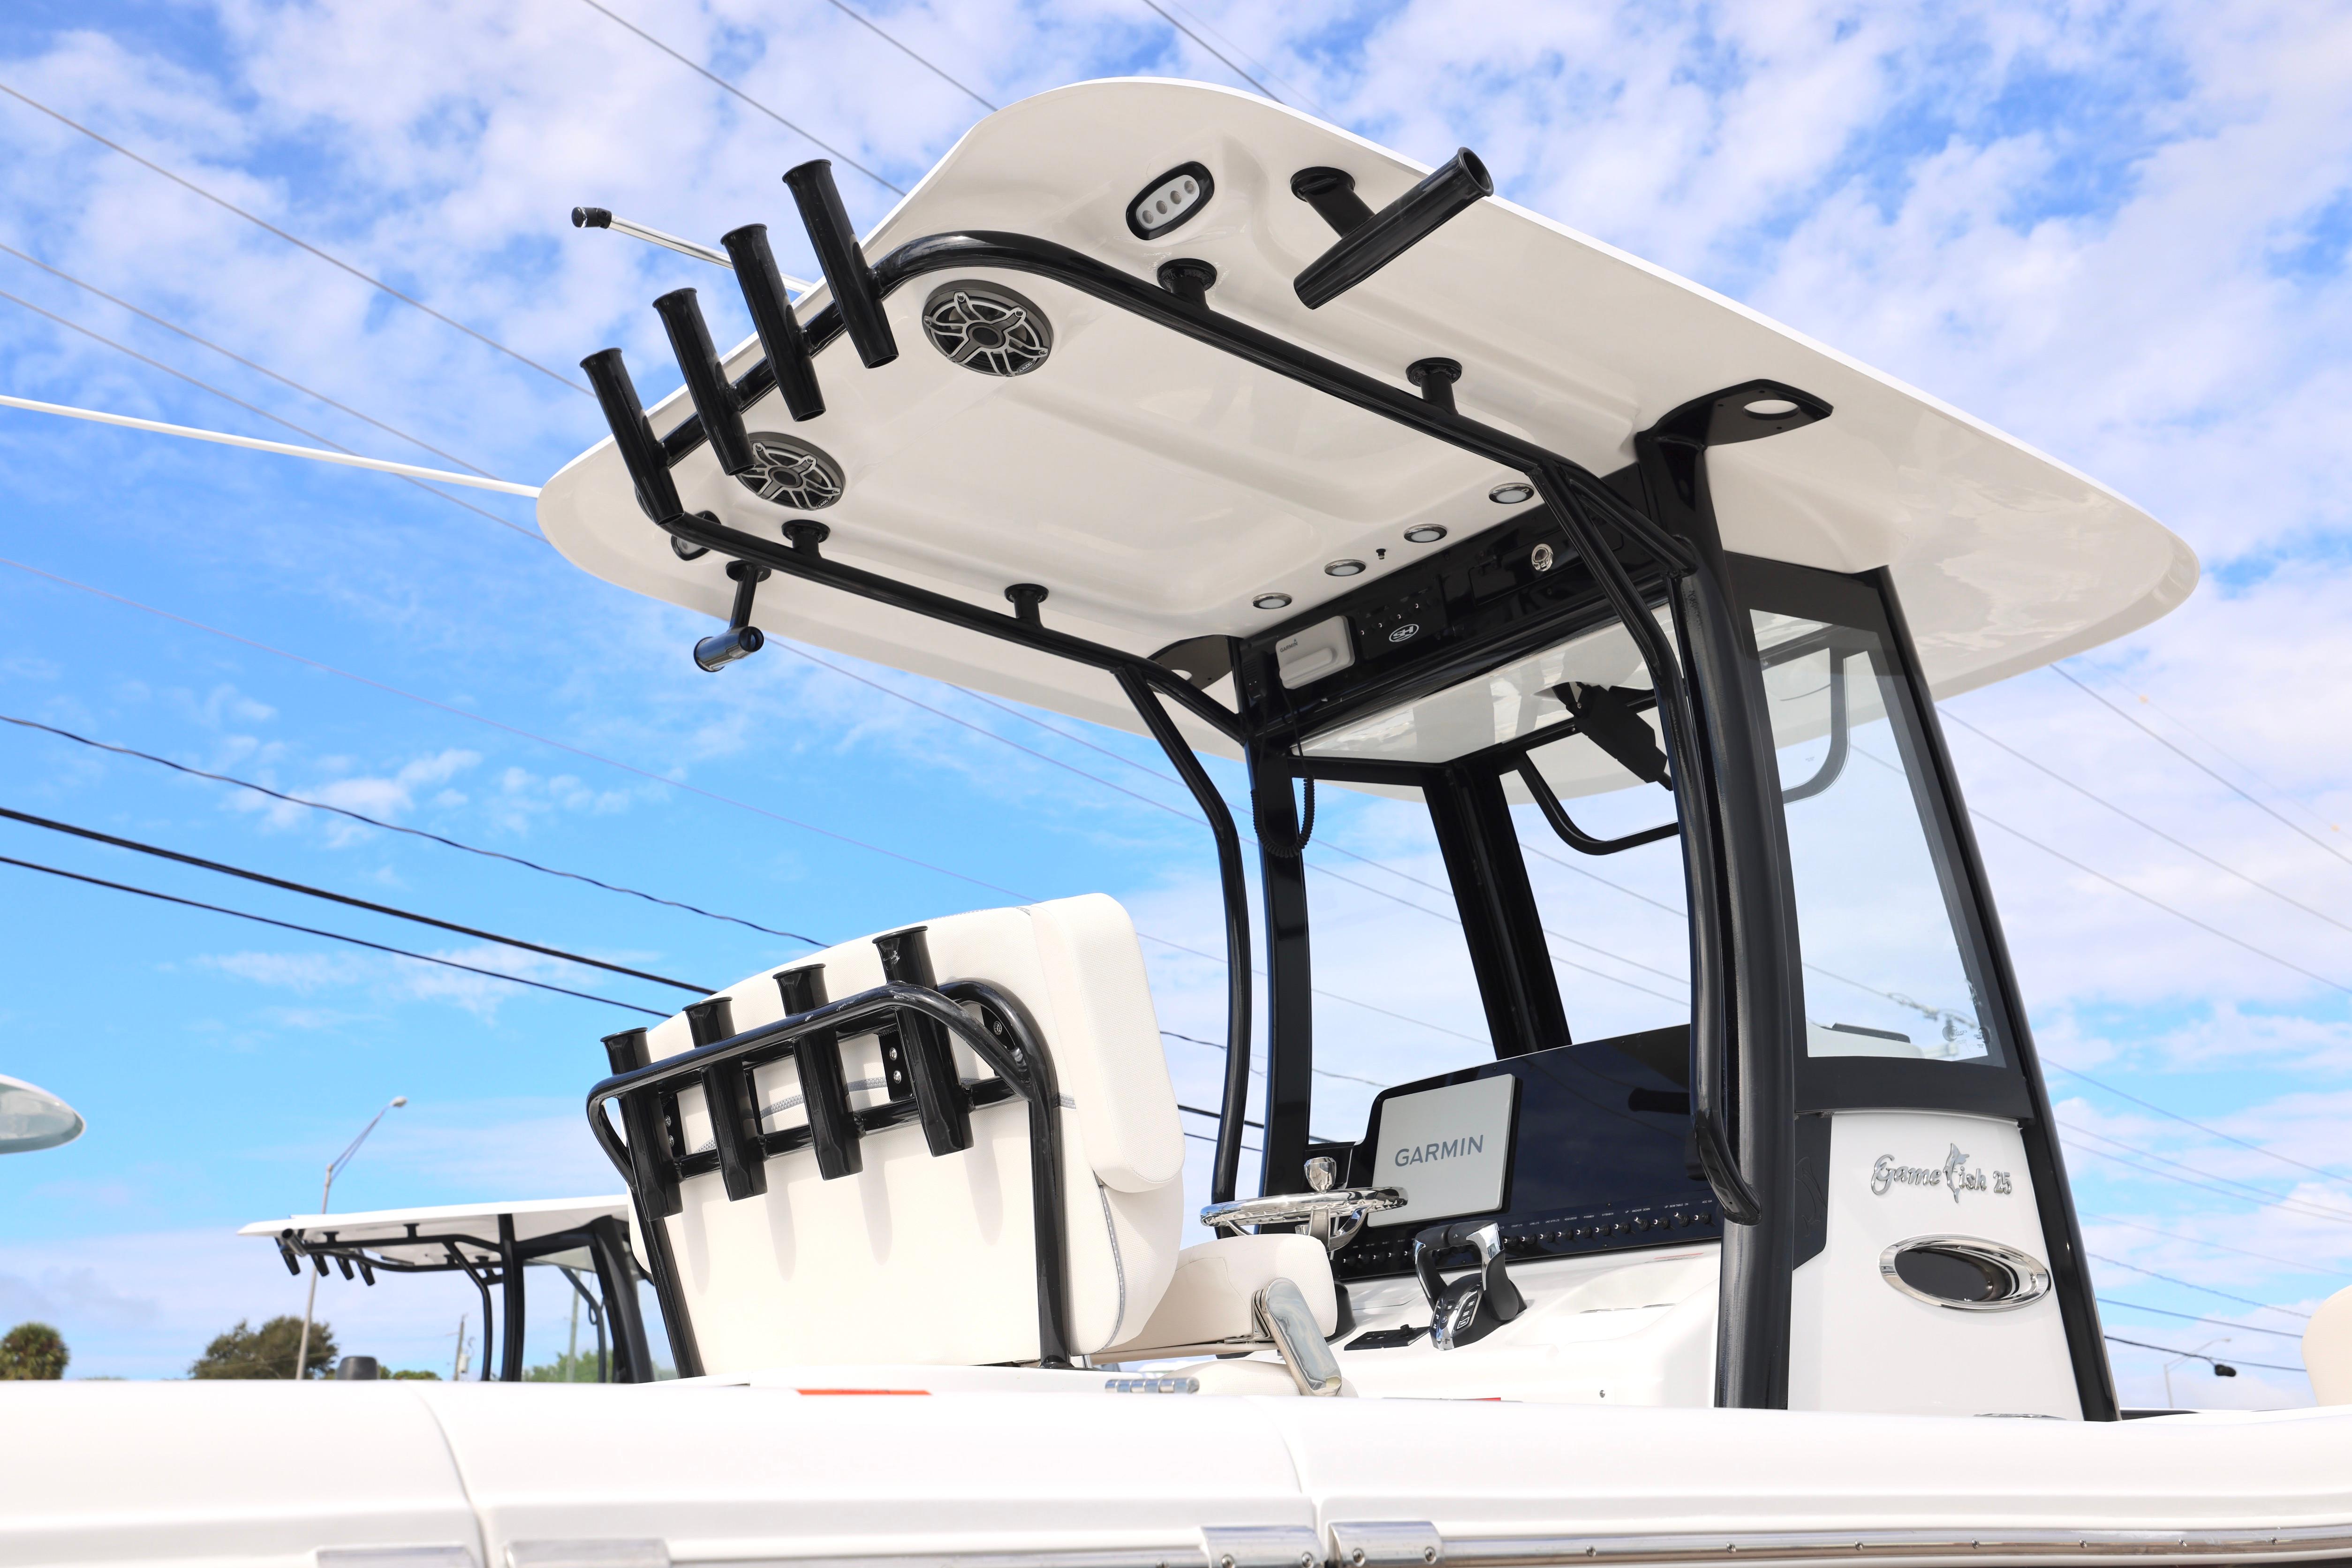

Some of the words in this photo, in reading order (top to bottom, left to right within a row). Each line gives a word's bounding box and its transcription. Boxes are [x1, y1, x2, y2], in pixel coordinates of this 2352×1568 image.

[1280, 641, 1298, 653] GARMIN
[1395, 1134, 1483, 1167] GARMIN
[1993, 1170, 2012, 1195] 25
